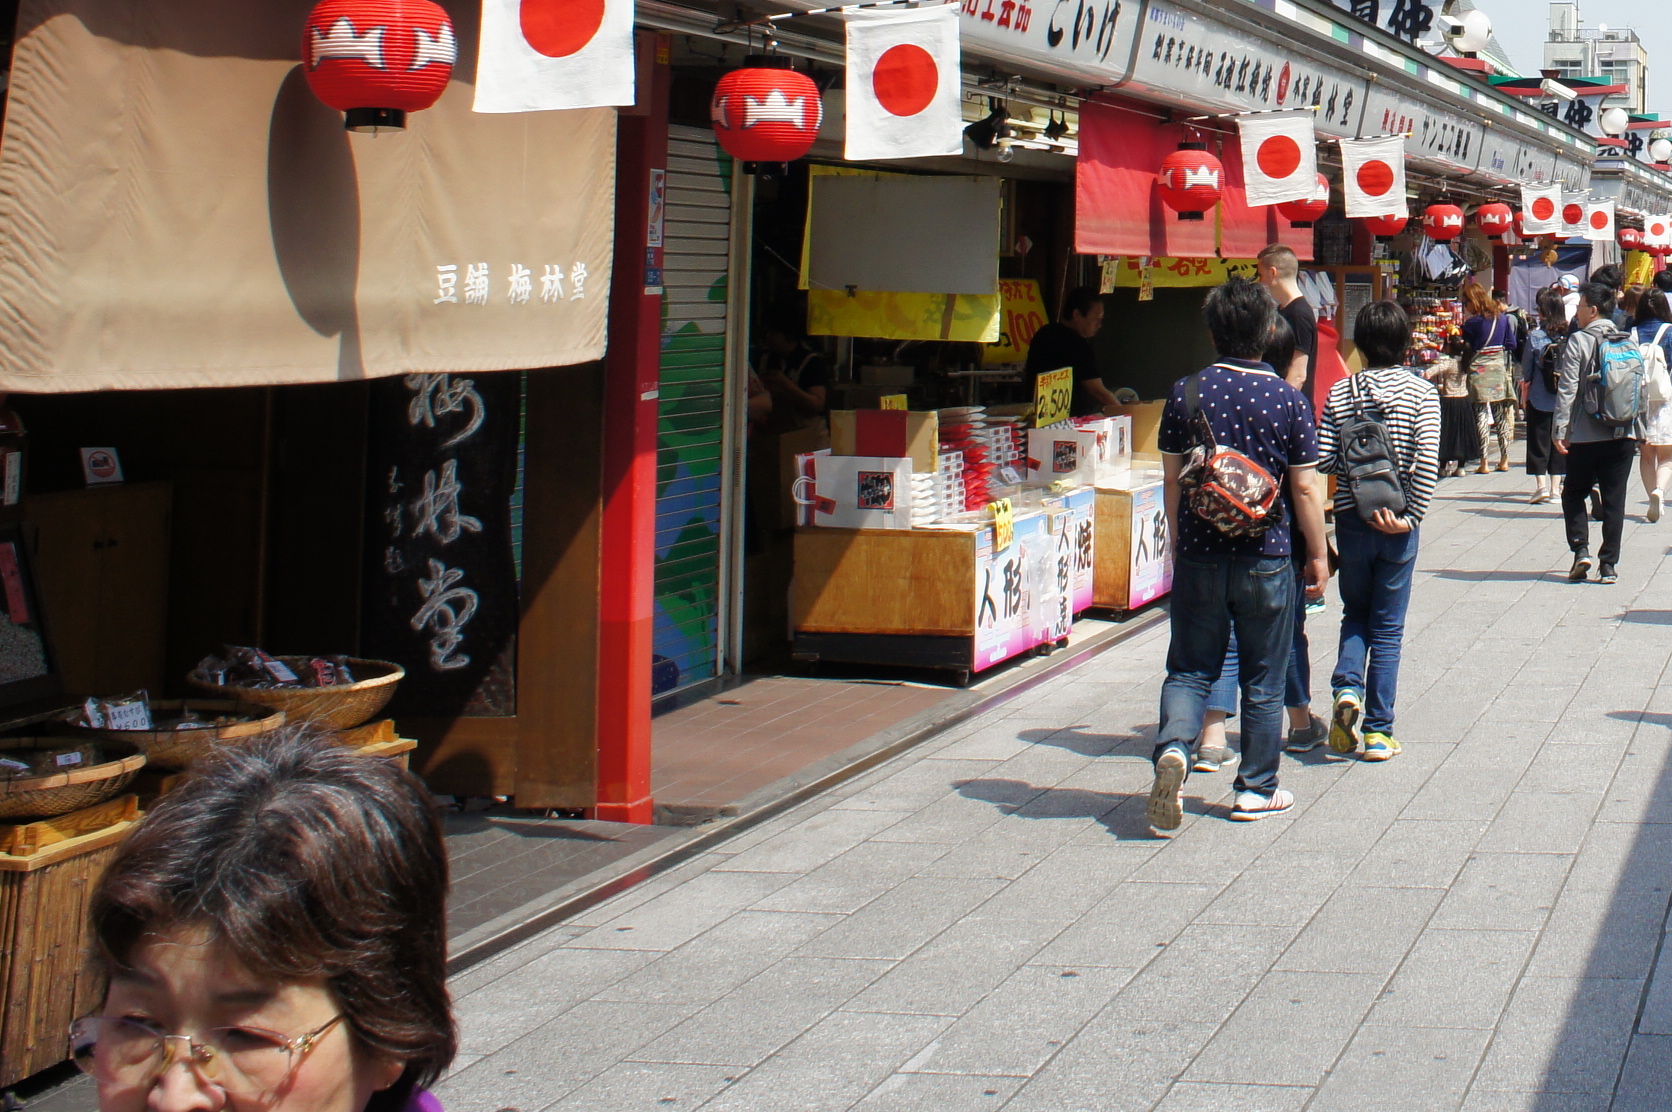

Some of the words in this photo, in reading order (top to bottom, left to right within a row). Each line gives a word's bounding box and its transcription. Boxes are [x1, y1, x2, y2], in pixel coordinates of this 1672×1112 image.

[1310, 75, 1354, 127] 梅林堂
[506, 261, 588, 305] 梅林堂
[978, 556, 1031, 629] 人形
[1054, 514, 1072, 637] 人形焼
